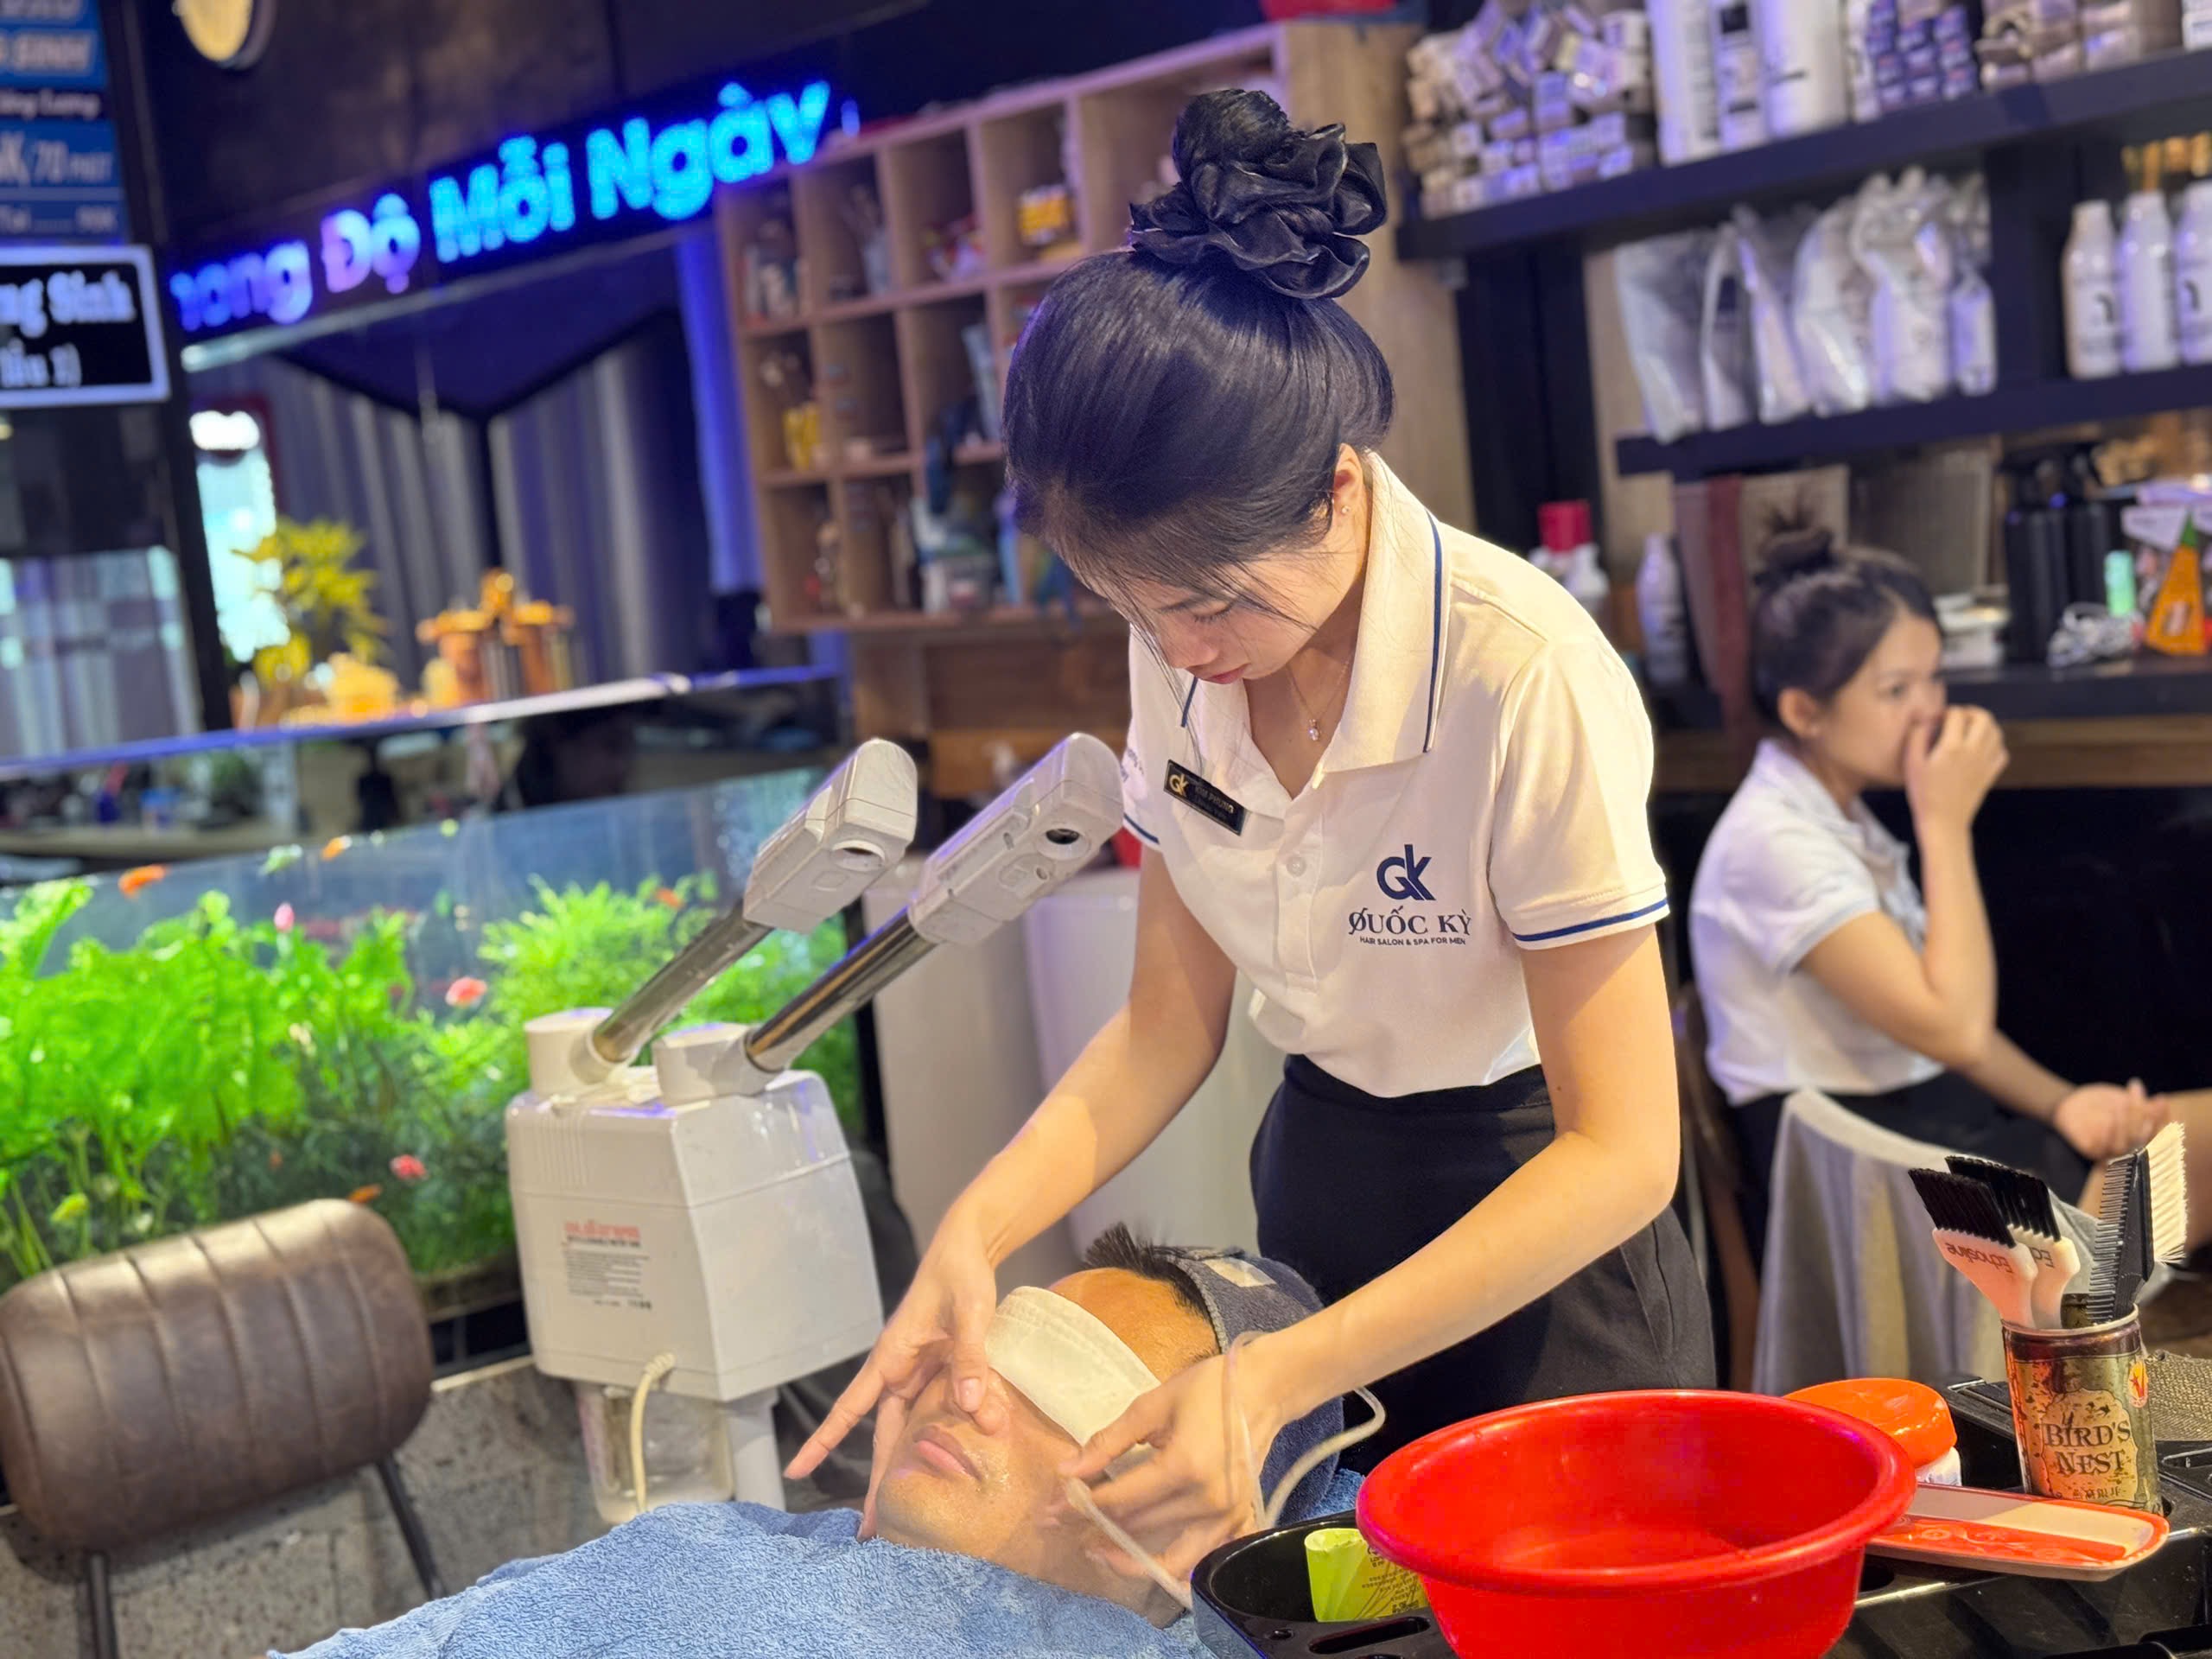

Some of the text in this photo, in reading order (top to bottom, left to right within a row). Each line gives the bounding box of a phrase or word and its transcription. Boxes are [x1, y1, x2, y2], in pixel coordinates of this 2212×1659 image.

[1437, 908, 1472, 936] KỲ
[1359, 935, 1466, 946] HAIR SALON & SPA FOR MEN
[2042, 1420, 2132, 1447] BIRD'S
[2053, 1448, 2126, 1476] NEST
